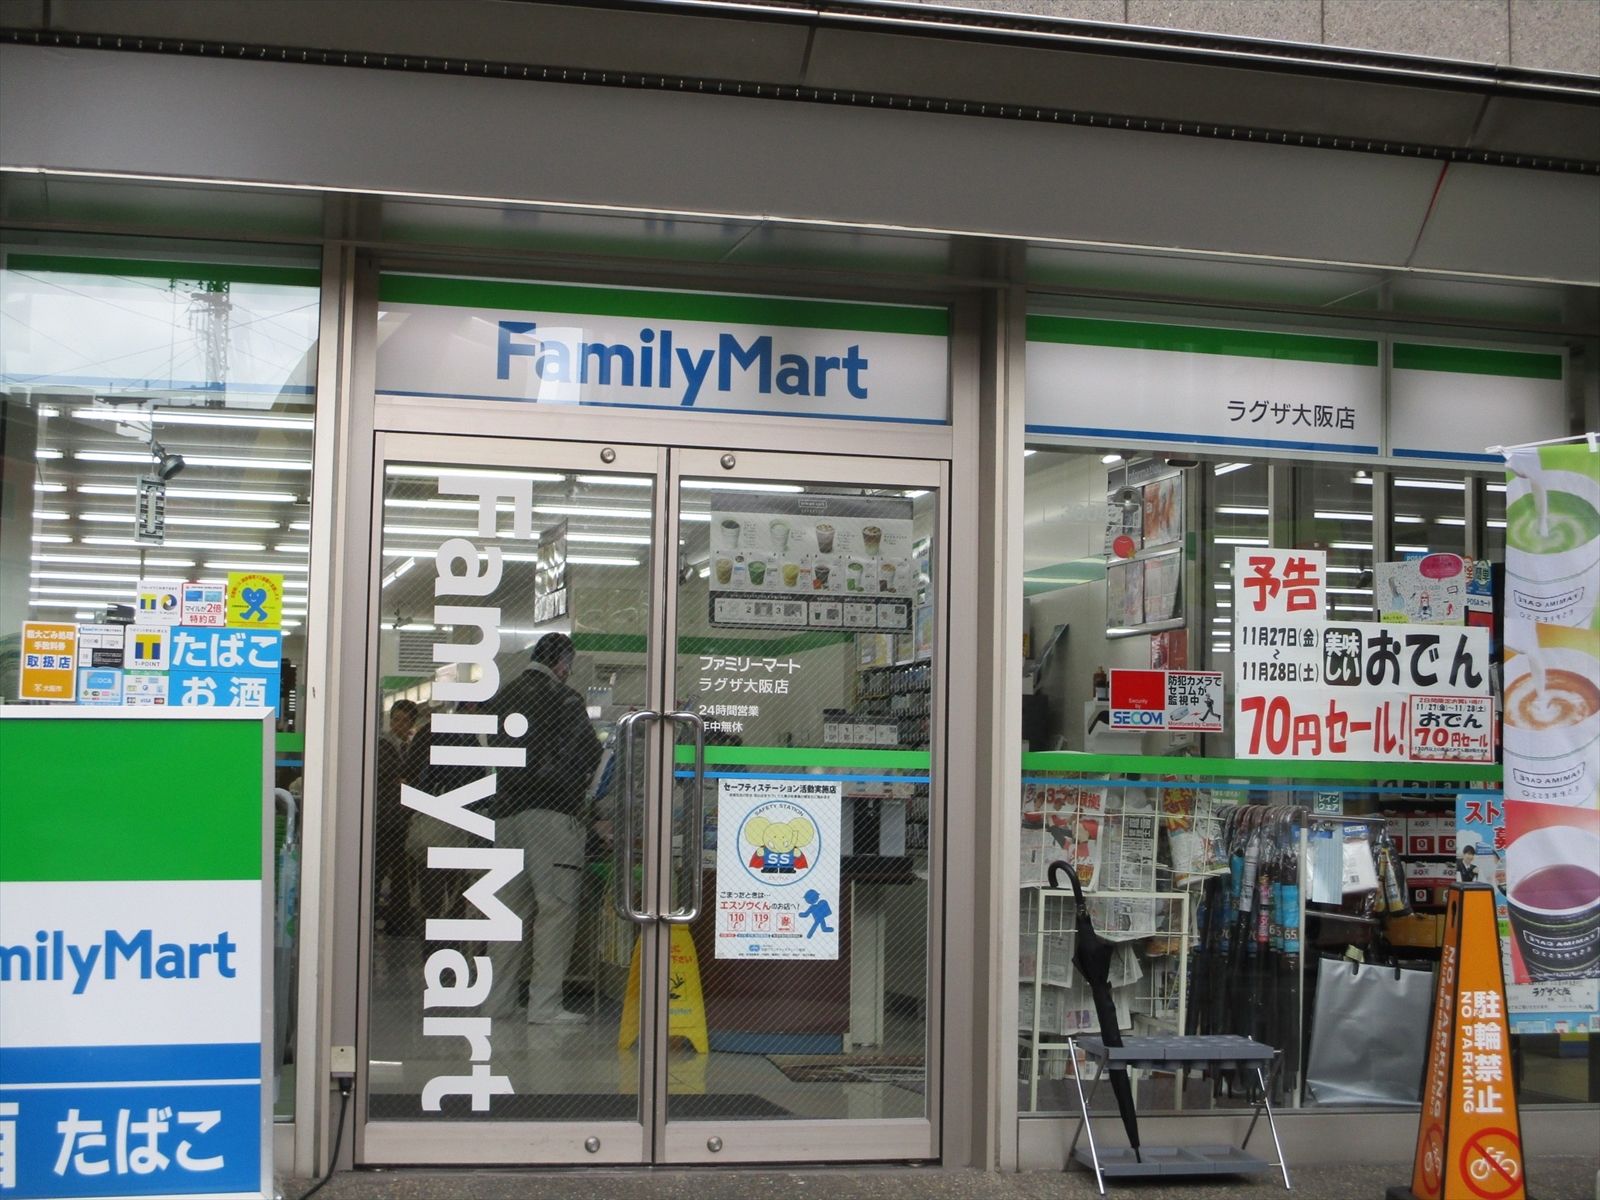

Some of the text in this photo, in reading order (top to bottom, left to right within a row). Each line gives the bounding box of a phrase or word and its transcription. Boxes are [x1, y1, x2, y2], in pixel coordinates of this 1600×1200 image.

[497, 320, 868, 405] FamilyMart
[1227, 400, 1355, 430] ラグザ大阪店
[1243, 556, 1320, 612] 予告
[190, 615, 217, 624] 特約店
[1243, 626, 1319, 648] 11月27日(金)
[172, 632, 278, 668] たばこ
[27, 655, 71, 669] 取扱店
[700, 656, 801, 674] ファミリーマート
[1366, 630, 1482, 689] おでん
[1168, 675, 1221, 686] 防犯カメラで
[1243, 661, 1319, 682] 11月28日(土)
[181, 676, 267, 706] お酒
[699, 678, 789, 694] ラグザ大阪店
[1169, 686, 1206, 696] セコムが
[1168, 696, 1199, 706] 監視中
[699, 705, 759, 716] 24時間営業
[1113, 712, 1162, 725] SECOM
[1241, 696, 1407, 756] 70円セール!
[1419, 712, 1482, 728] おでん
[1415, 728, 1488, 747] 70円セール
[401, 475, 533, 1111] FamilyMart
[723, 783, 837, 794] セーフティステーション活動実施店
[755, 804, 804, 817] SAFETY STATION
[1464, 800, 1504, 824] スト
[768, 853, 790, 864] SS
[729, 913, 744, 922] 110
[754, 914, 769, 922] 119
[1284, 929, 1297, 940] 65
[1446, 946, 1455, 984] NO
[1461, 991, 1475, 1113] NO PARKING
[1474, 990, 1503, 1113] 駐輪禁止
[53, 1106, 224, 1176] たばこ
